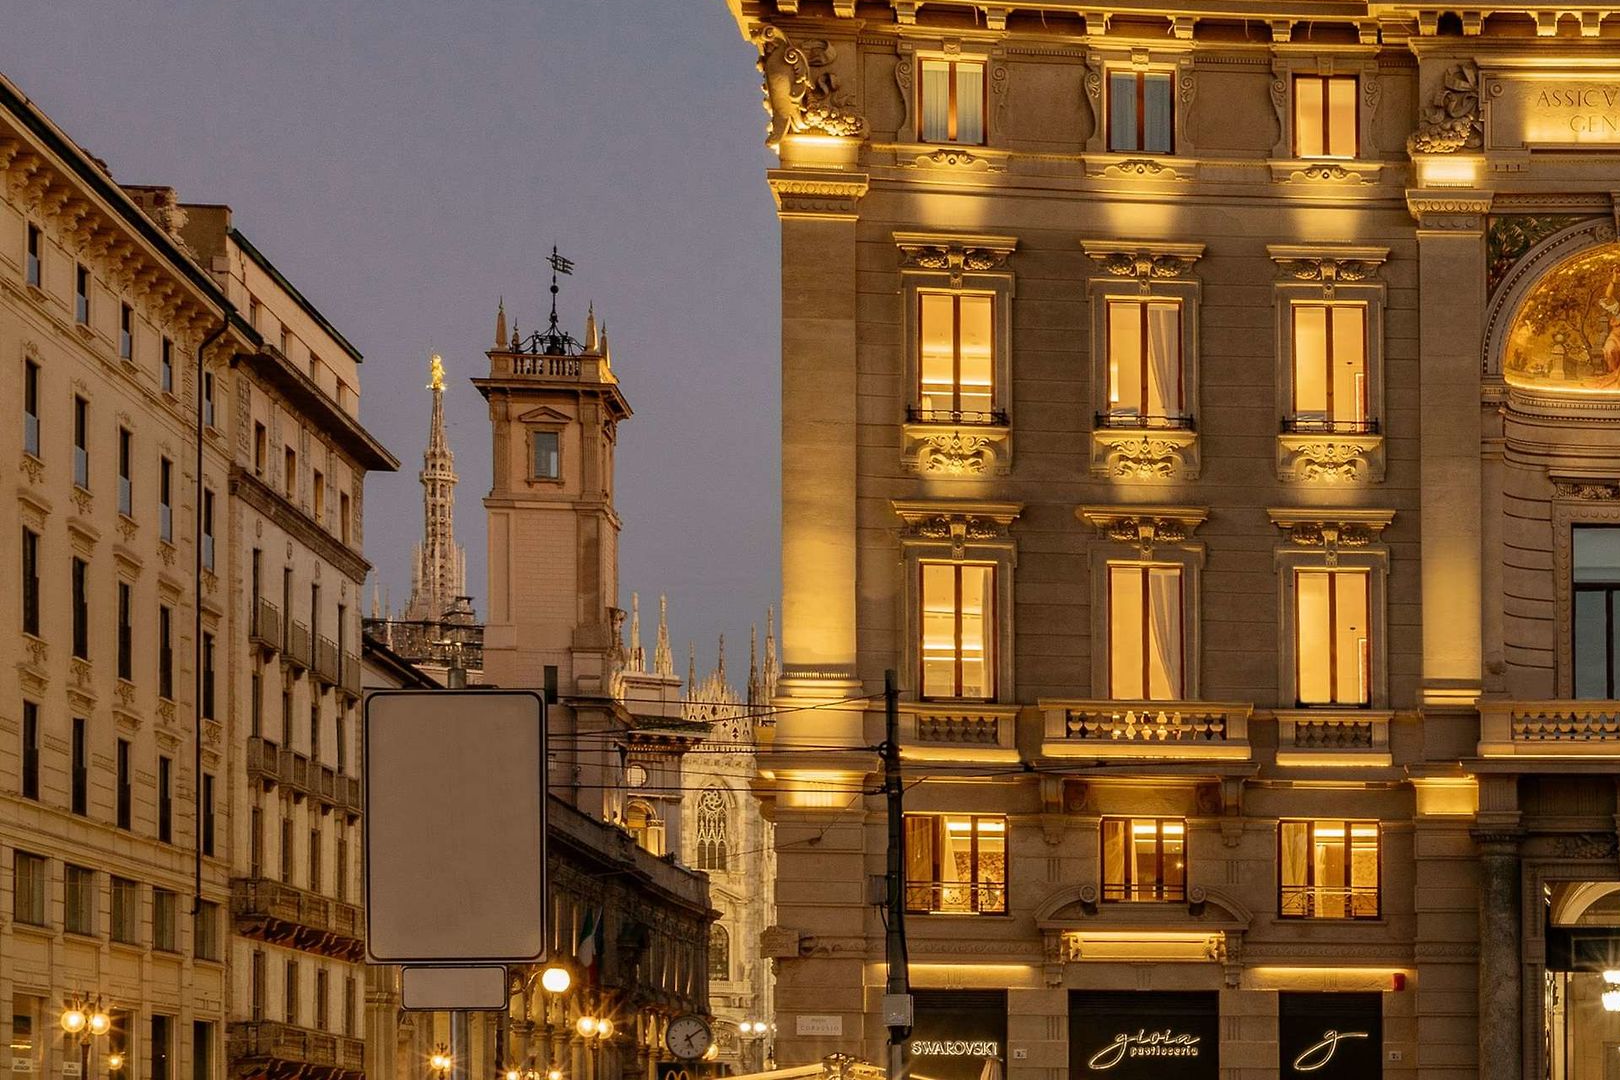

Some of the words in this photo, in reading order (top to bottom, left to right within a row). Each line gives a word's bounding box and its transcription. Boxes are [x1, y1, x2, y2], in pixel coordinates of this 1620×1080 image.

[911, 1041, 998, 1055] SWAROVSKI
[1088, 1029, 1200, 1069] gioia
[1130, 1046, 1199, 1057] pasticceria
